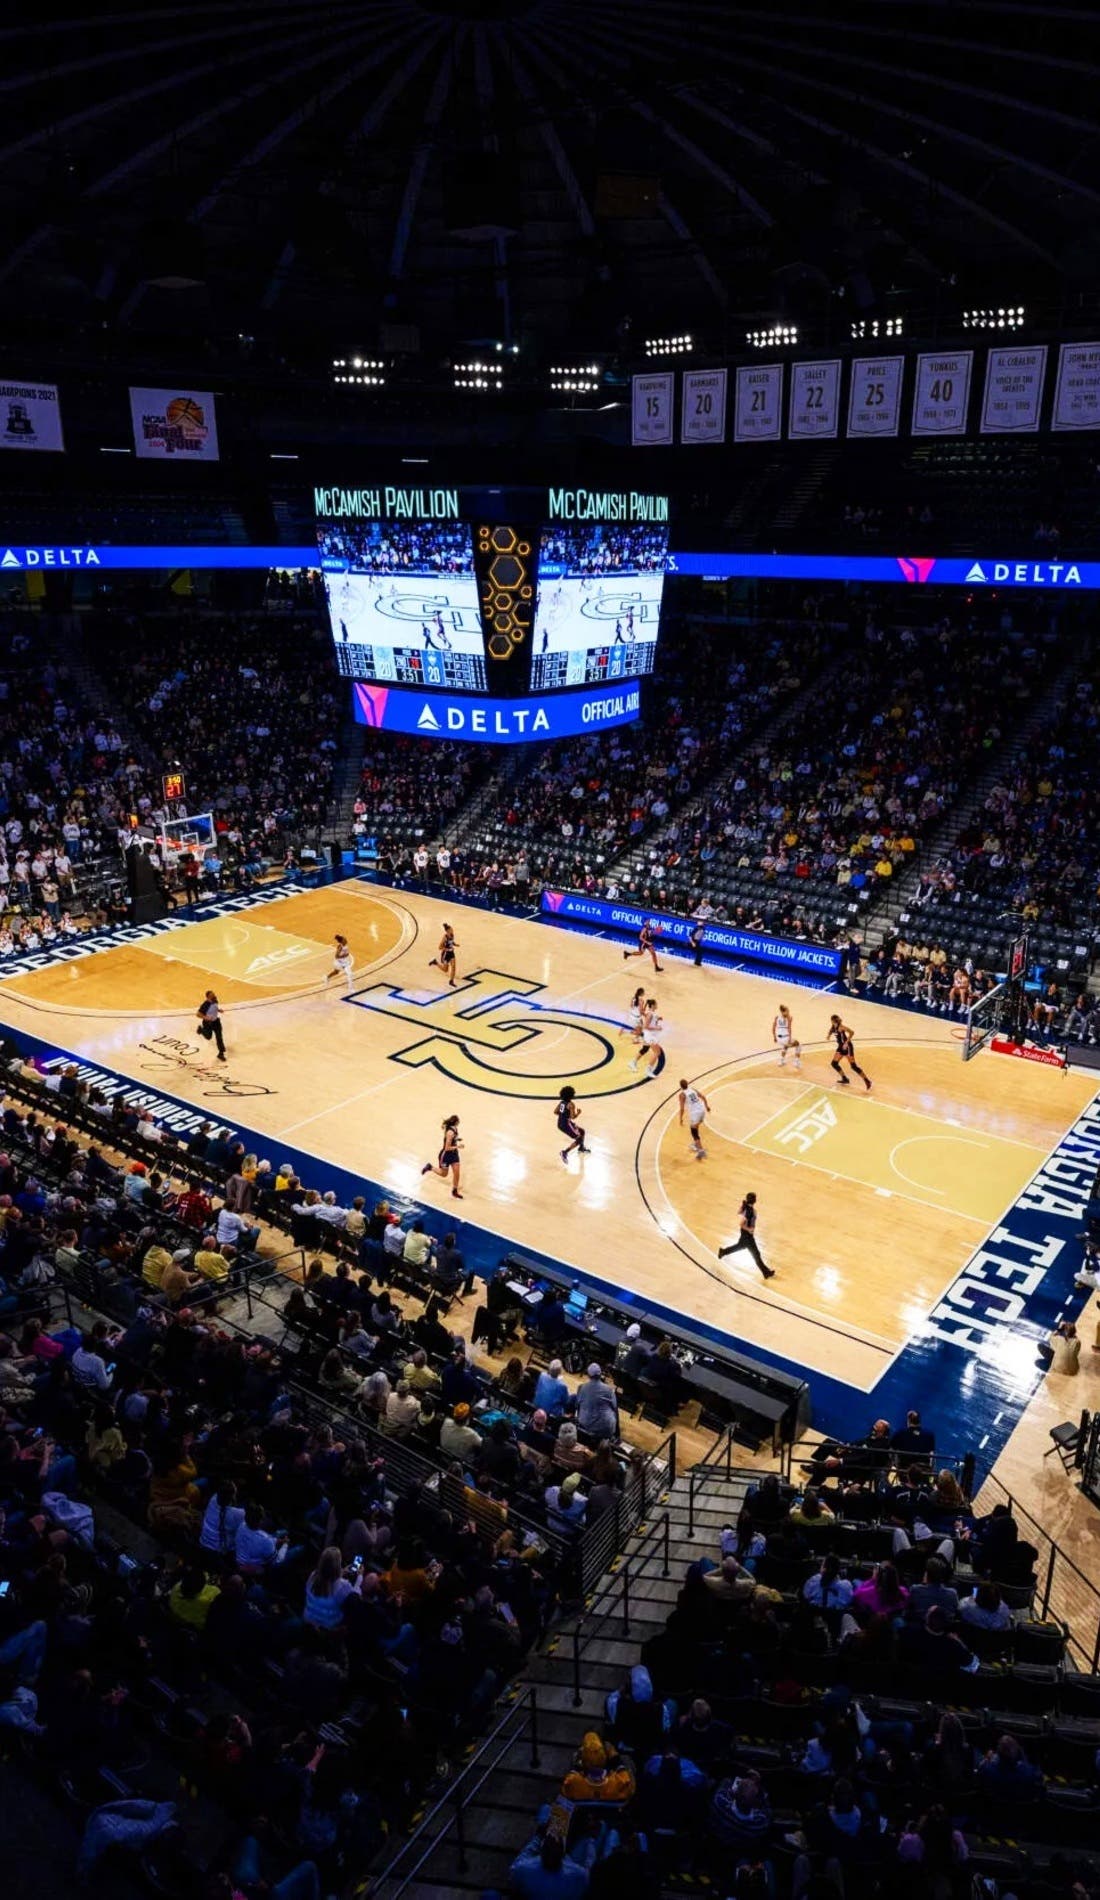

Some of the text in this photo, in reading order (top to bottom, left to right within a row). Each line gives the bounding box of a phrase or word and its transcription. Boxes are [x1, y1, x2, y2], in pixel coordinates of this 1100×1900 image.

[38, 389, 57, 401] 2021
[751, 390, 766, 411] 21
[806, 386, 823, 409] 22
[866, 384, 884, 406] 25
[930, 379, 953, 402] 40
[646, 396, 660, 417] 15
[696, 394, 713, 415] 20
[385, 487, 459, 519] PAVILION
[630, 492, 669, 522] PAVILION
[26, 549, 101, 565] DELTA
[994, 563, 1081, 584] DELTA
[380, 663, 392, 679] 20
[428, 666, 441, 683] 20
[612, 660, 622, 676] 20
[582, 696, 624, 723] OFFICIAL
[447, 707, 550, 735] DELTA
[0, 883, 314, 980] GEORGIA TECH
[575, 904, 602, 915] DELTA
[612, 910, 642, 926] OFFICIAL
[674, 924, 684, 934] OF
[740, 938, 761, 952] TECH
[763, 942, 796, 959] YELLOW
[798, 950, 837, 968] JACKETS.
[243, 944, 314, 974] ACC
